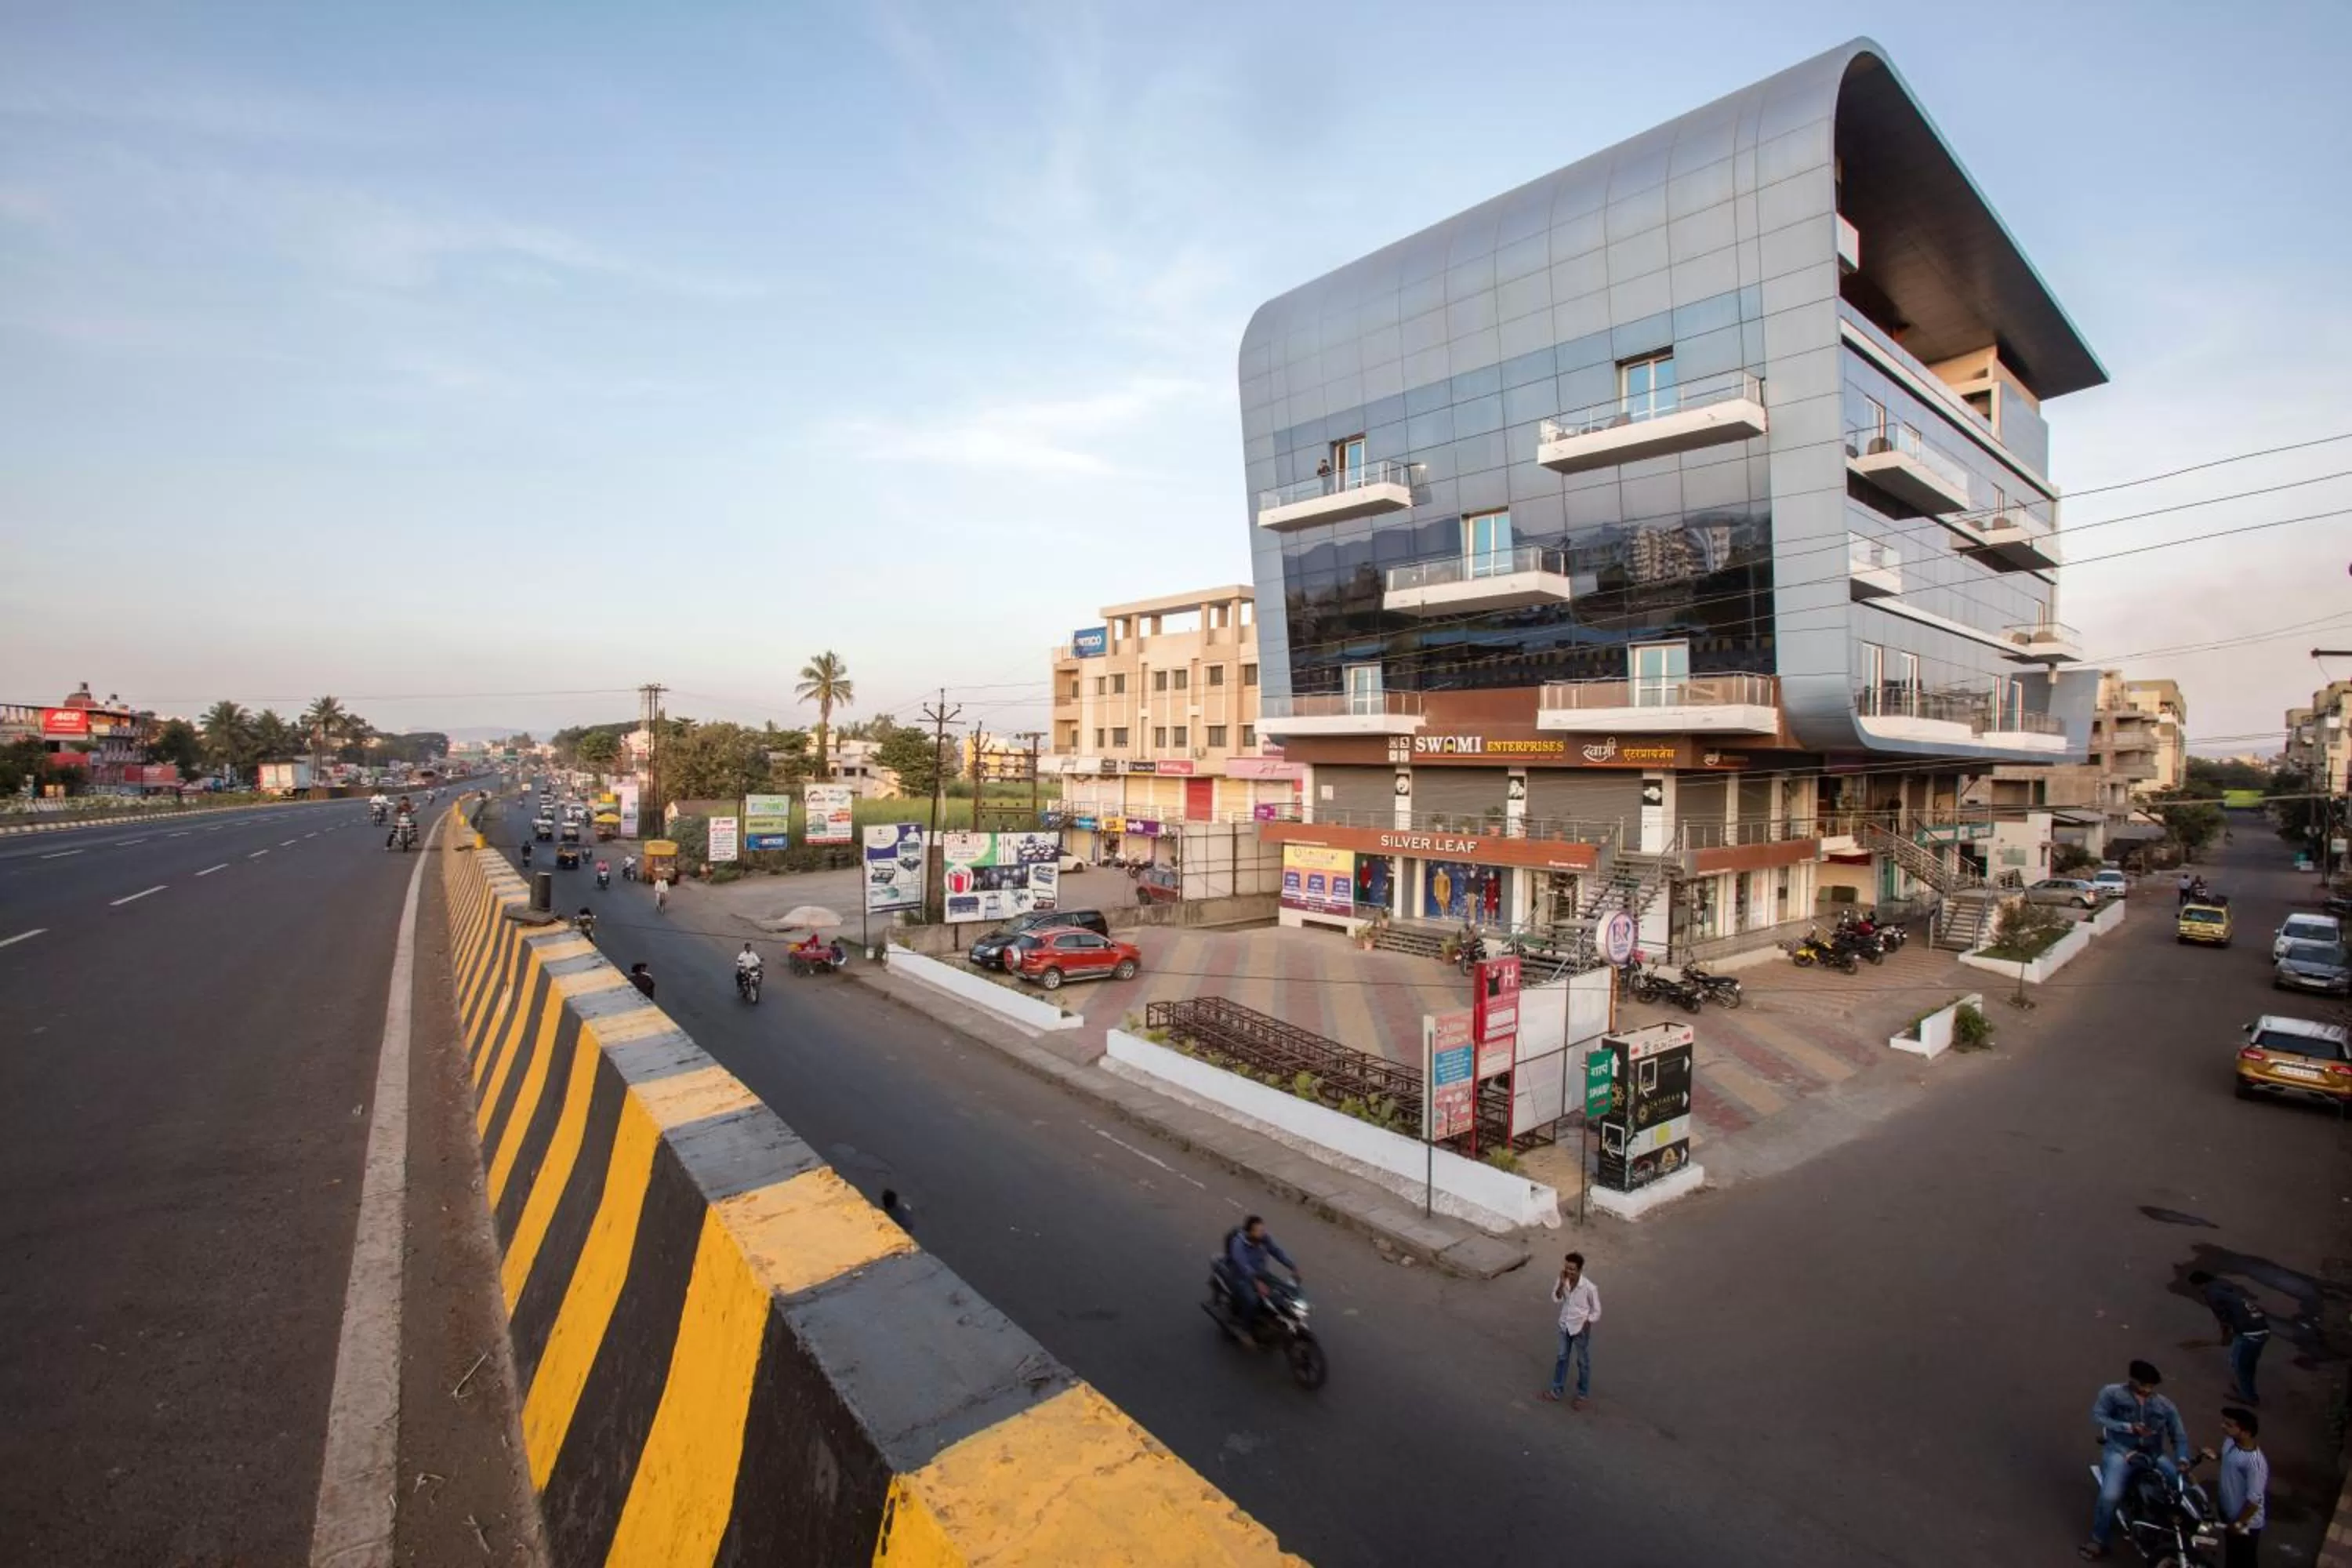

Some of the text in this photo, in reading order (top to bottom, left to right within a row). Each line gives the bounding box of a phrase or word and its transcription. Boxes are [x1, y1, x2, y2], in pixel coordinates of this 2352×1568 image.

[1414, 736, 1565, 753] SWAMI ENTERPRISES
[1381, 834, 1477, 854] SILVER LEAF
